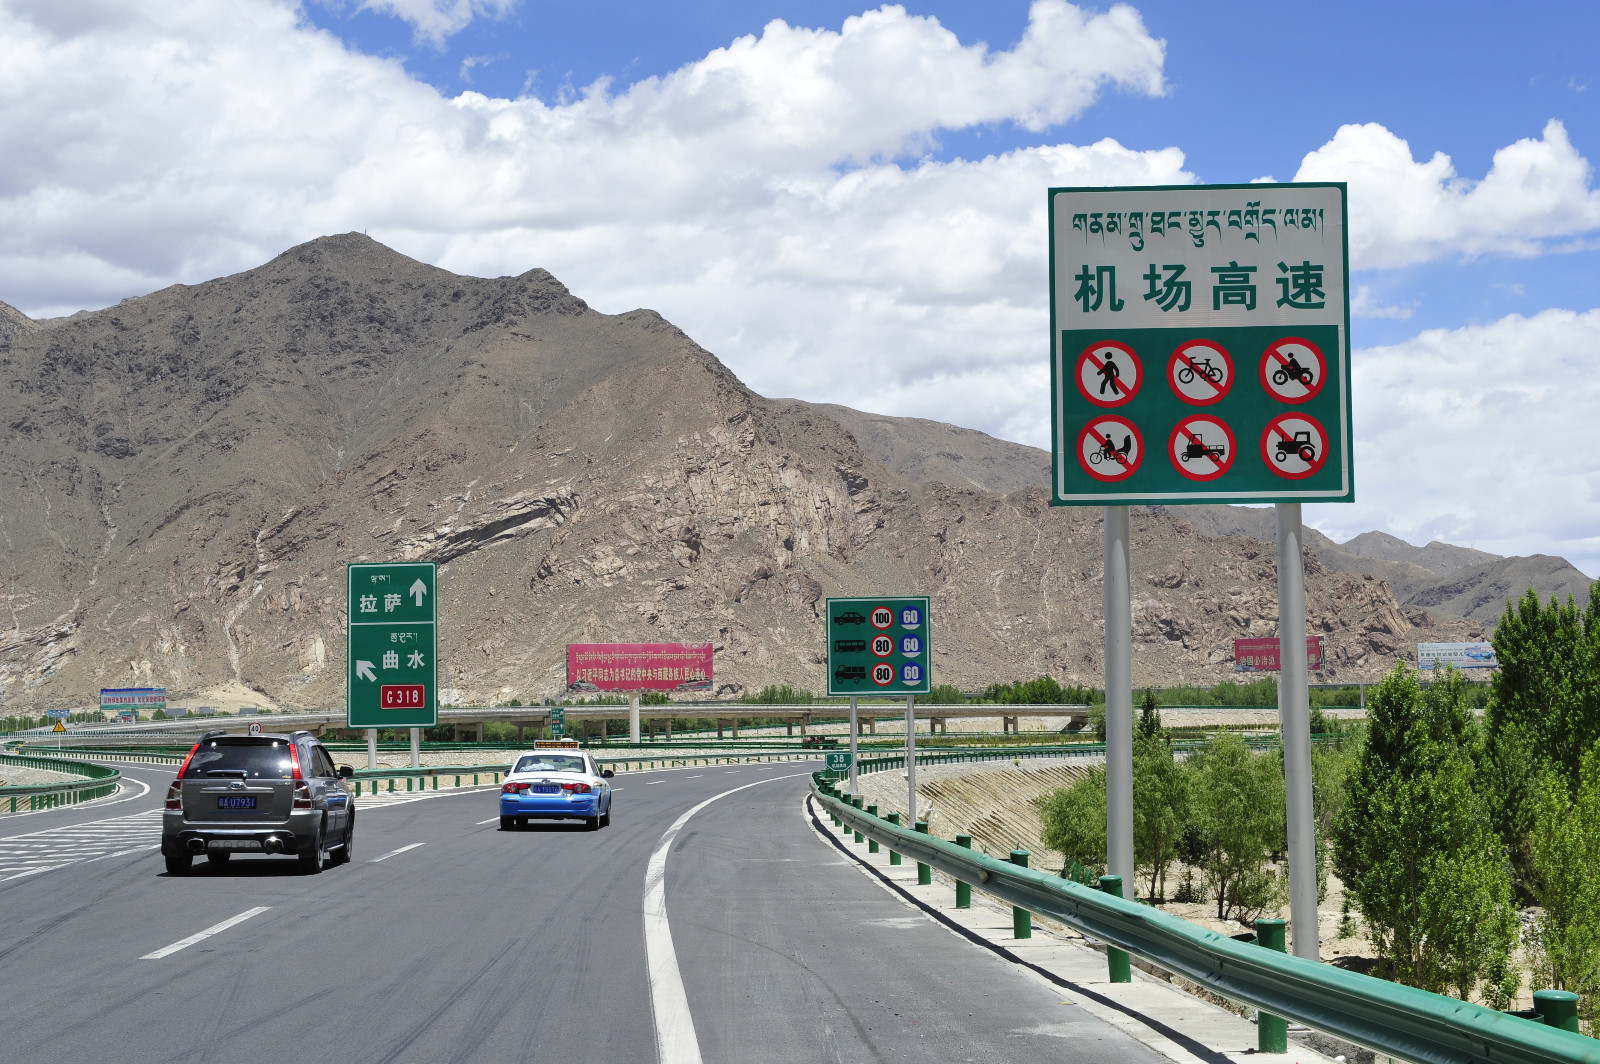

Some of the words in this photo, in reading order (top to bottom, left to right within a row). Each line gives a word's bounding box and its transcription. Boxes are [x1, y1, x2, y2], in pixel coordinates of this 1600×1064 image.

[1074, 260, 1326, 313] 机场高速
[359, 593, 402, 613] 拉萨
[874, 612, 890, 624] 100
[903, 609, 918, 624] 60
[875, 639, 890, 652] 80
[903, 637, 919, 652] 60
[382, 650, 426, 670] 曲水
[876, 667, 890, 681] 80
[904, 665, 919, 680] 60
[386, 690, 419, 704] G318
[833, 754, 845, 763] 38
